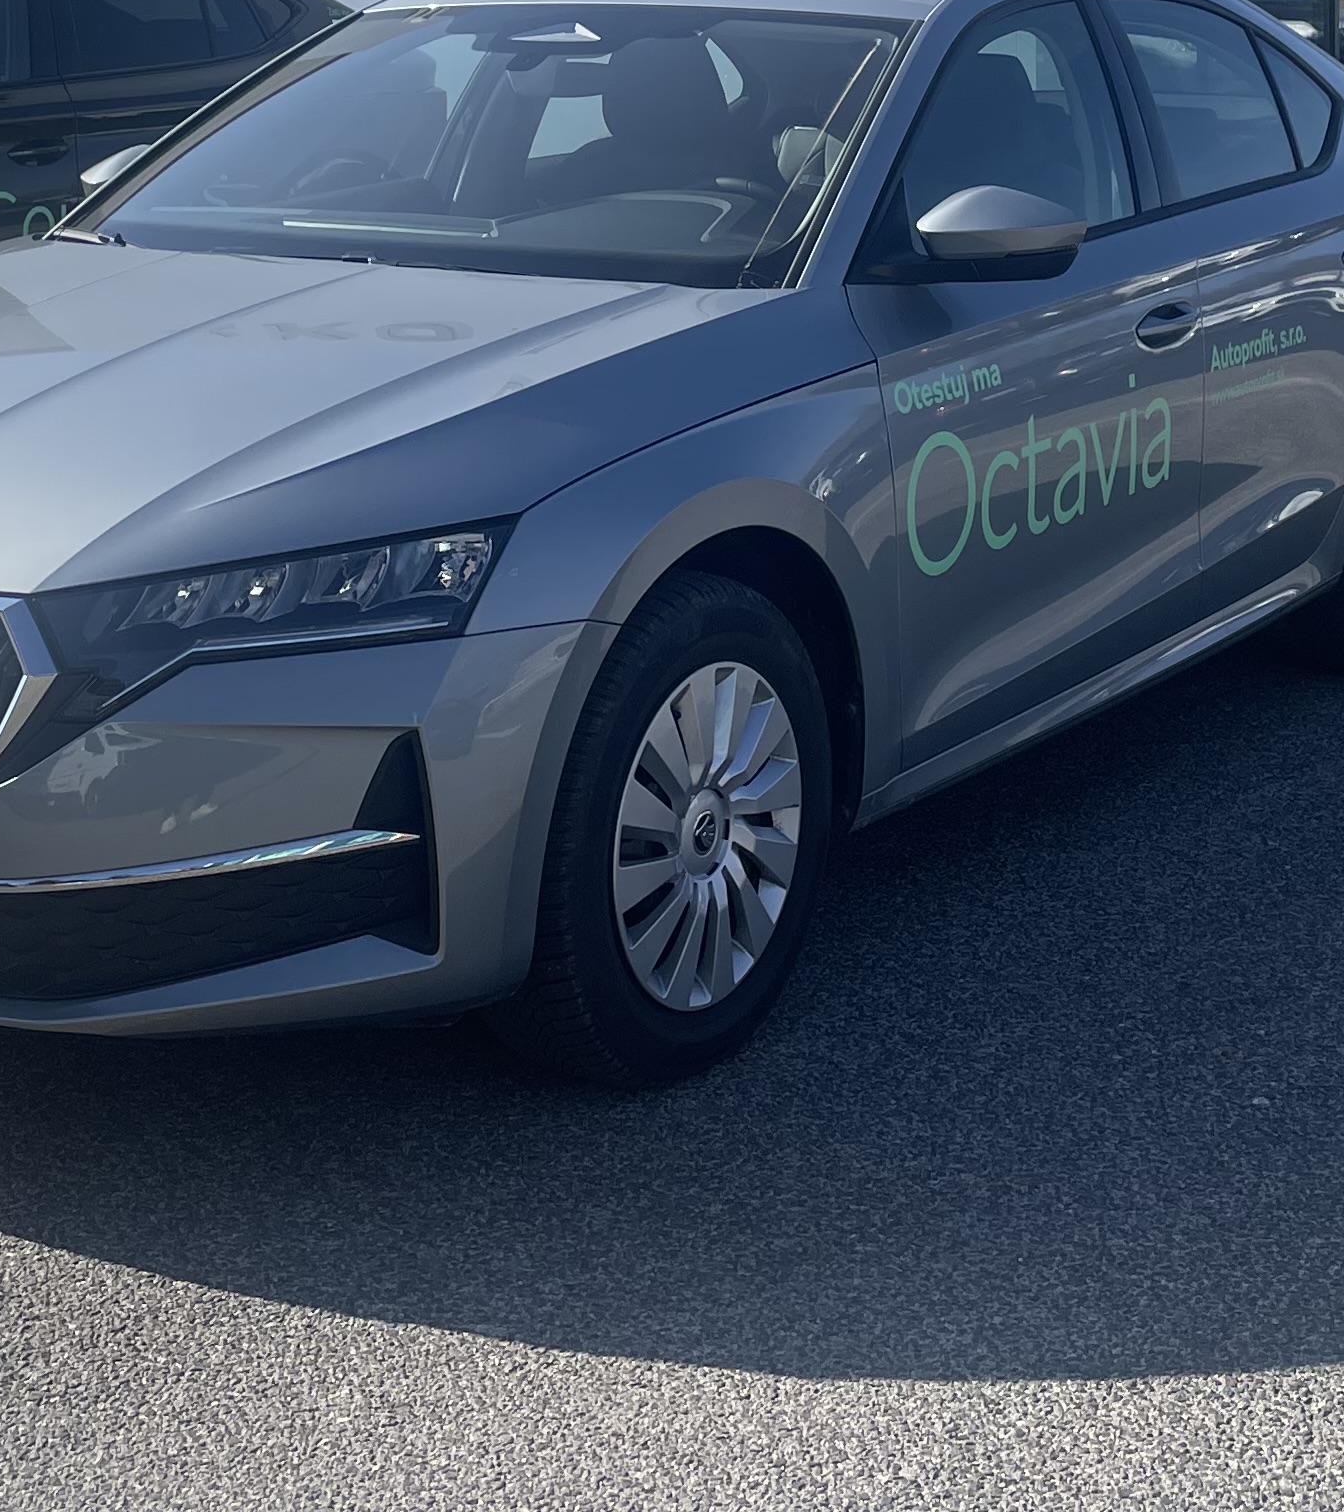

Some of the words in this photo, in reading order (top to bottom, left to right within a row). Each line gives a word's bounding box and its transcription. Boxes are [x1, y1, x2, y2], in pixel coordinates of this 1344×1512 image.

[1210, 328, 1278, 372] Autoprofit,
[1279, 325, 1307, 349] s.r.o.
[894, 364, 970, 415] Otestuj
[971, 363, 1002, 392] ma
[907, 373, 1171, 577] Octavia
